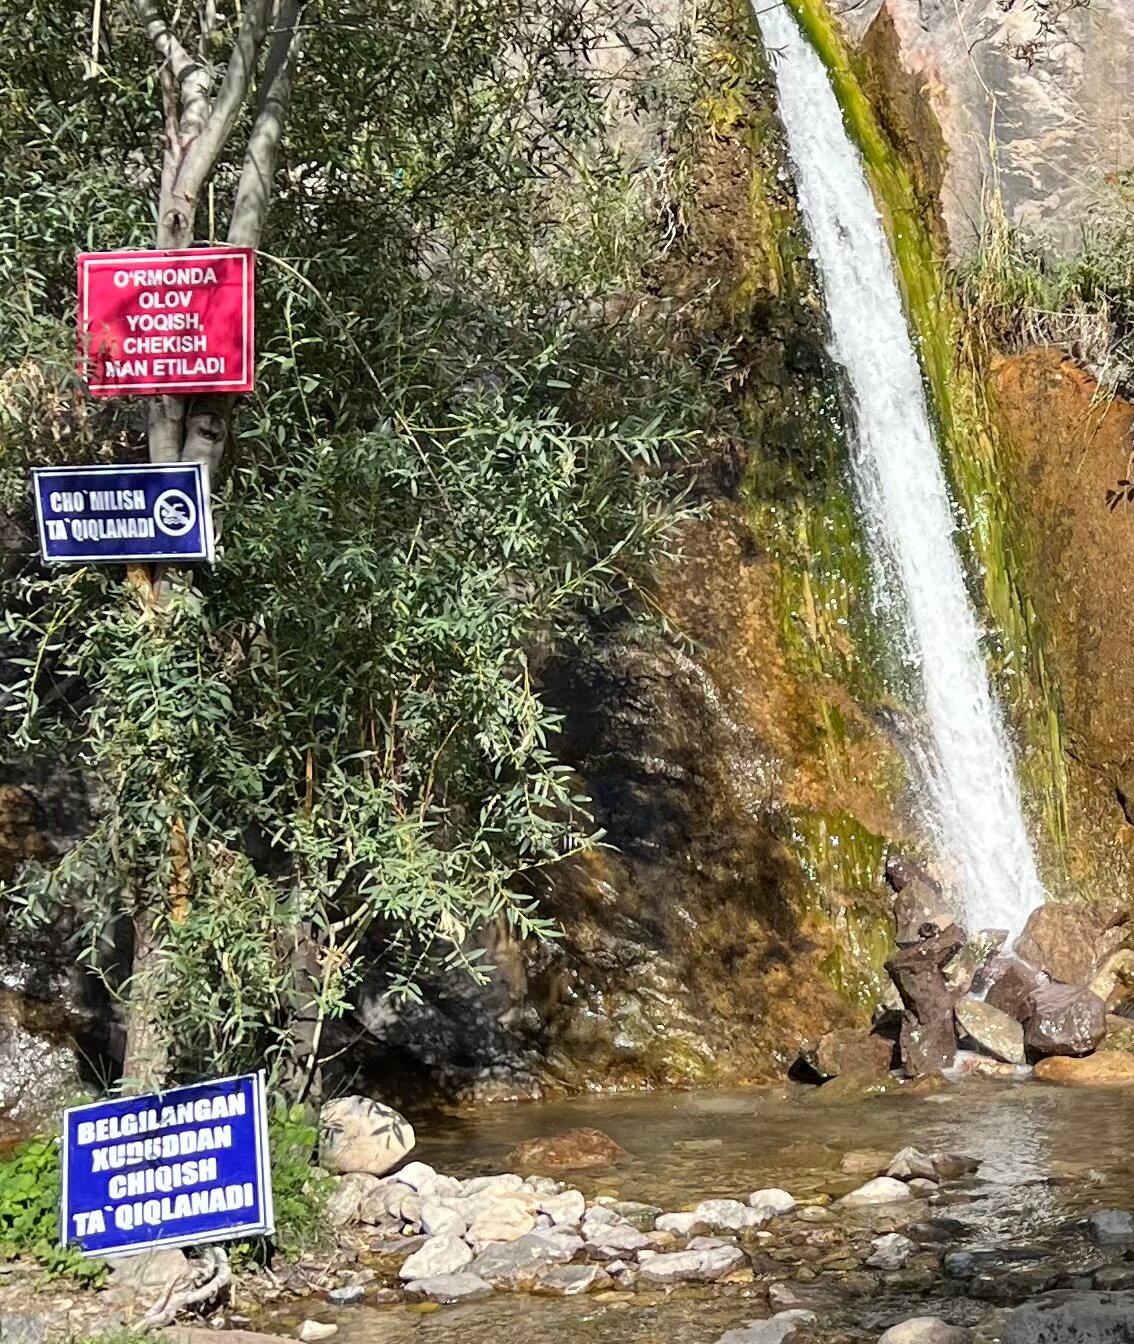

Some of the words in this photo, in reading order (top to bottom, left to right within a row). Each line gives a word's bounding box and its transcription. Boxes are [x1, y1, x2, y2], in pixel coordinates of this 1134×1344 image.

[139, 291, 192, 309] OLOV
[127, 313, 204, 331] YOQISH,
[123, 336, 206, 353] CHEKISH
[106, 360, 147, 377] MAN
[153, 358, 225, 376] ETILADI
[77, 1092, 245, 1145] BELGILANGAN
[109, 1157, 217, 1199] CHIQISH
